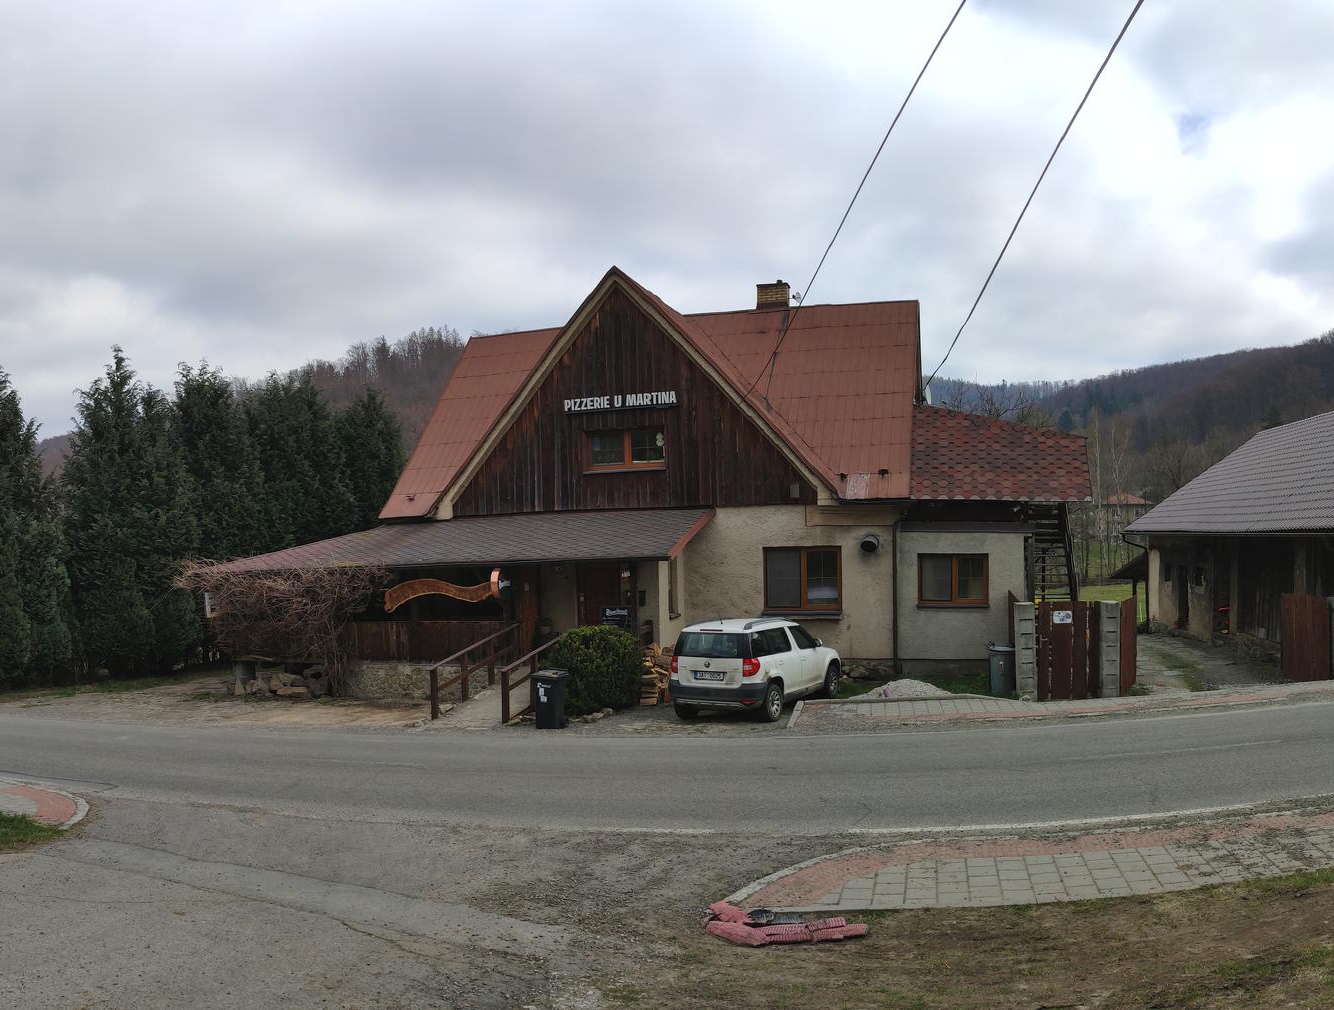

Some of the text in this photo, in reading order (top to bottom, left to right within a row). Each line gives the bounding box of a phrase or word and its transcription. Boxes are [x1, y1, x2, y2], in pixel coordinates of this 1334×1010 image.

[564, 391, 677, 412] PIZZERIE U MARTINA
